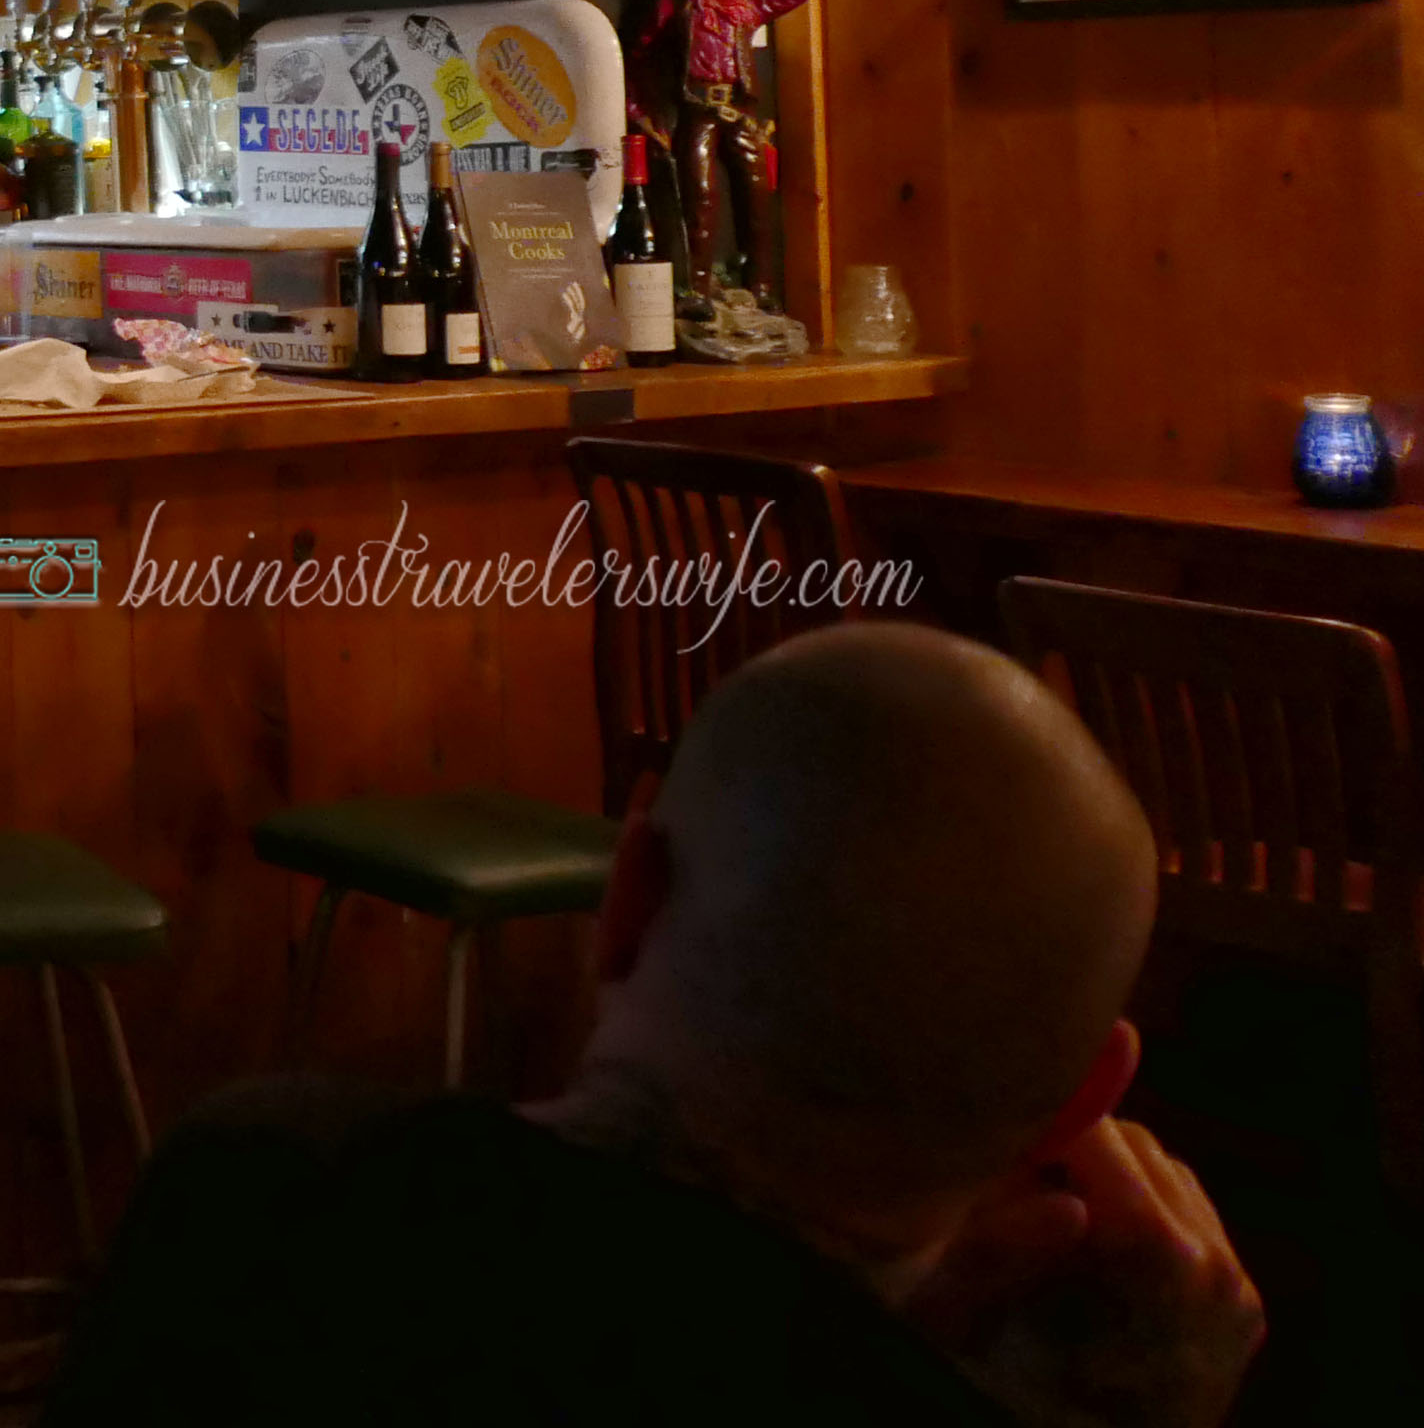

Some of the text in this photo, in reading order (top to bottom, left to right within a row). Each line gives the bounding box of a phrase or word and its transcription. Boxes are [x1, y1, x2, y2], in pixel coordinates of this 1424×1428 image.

[489, 36, 569, 127] Shiner
[490, 220, 574, 240] Montreal
[508, 242, 566, 260] Cooks
[251, 342, 284, 364] AND
[289, 344, 329, 367] TAKE
